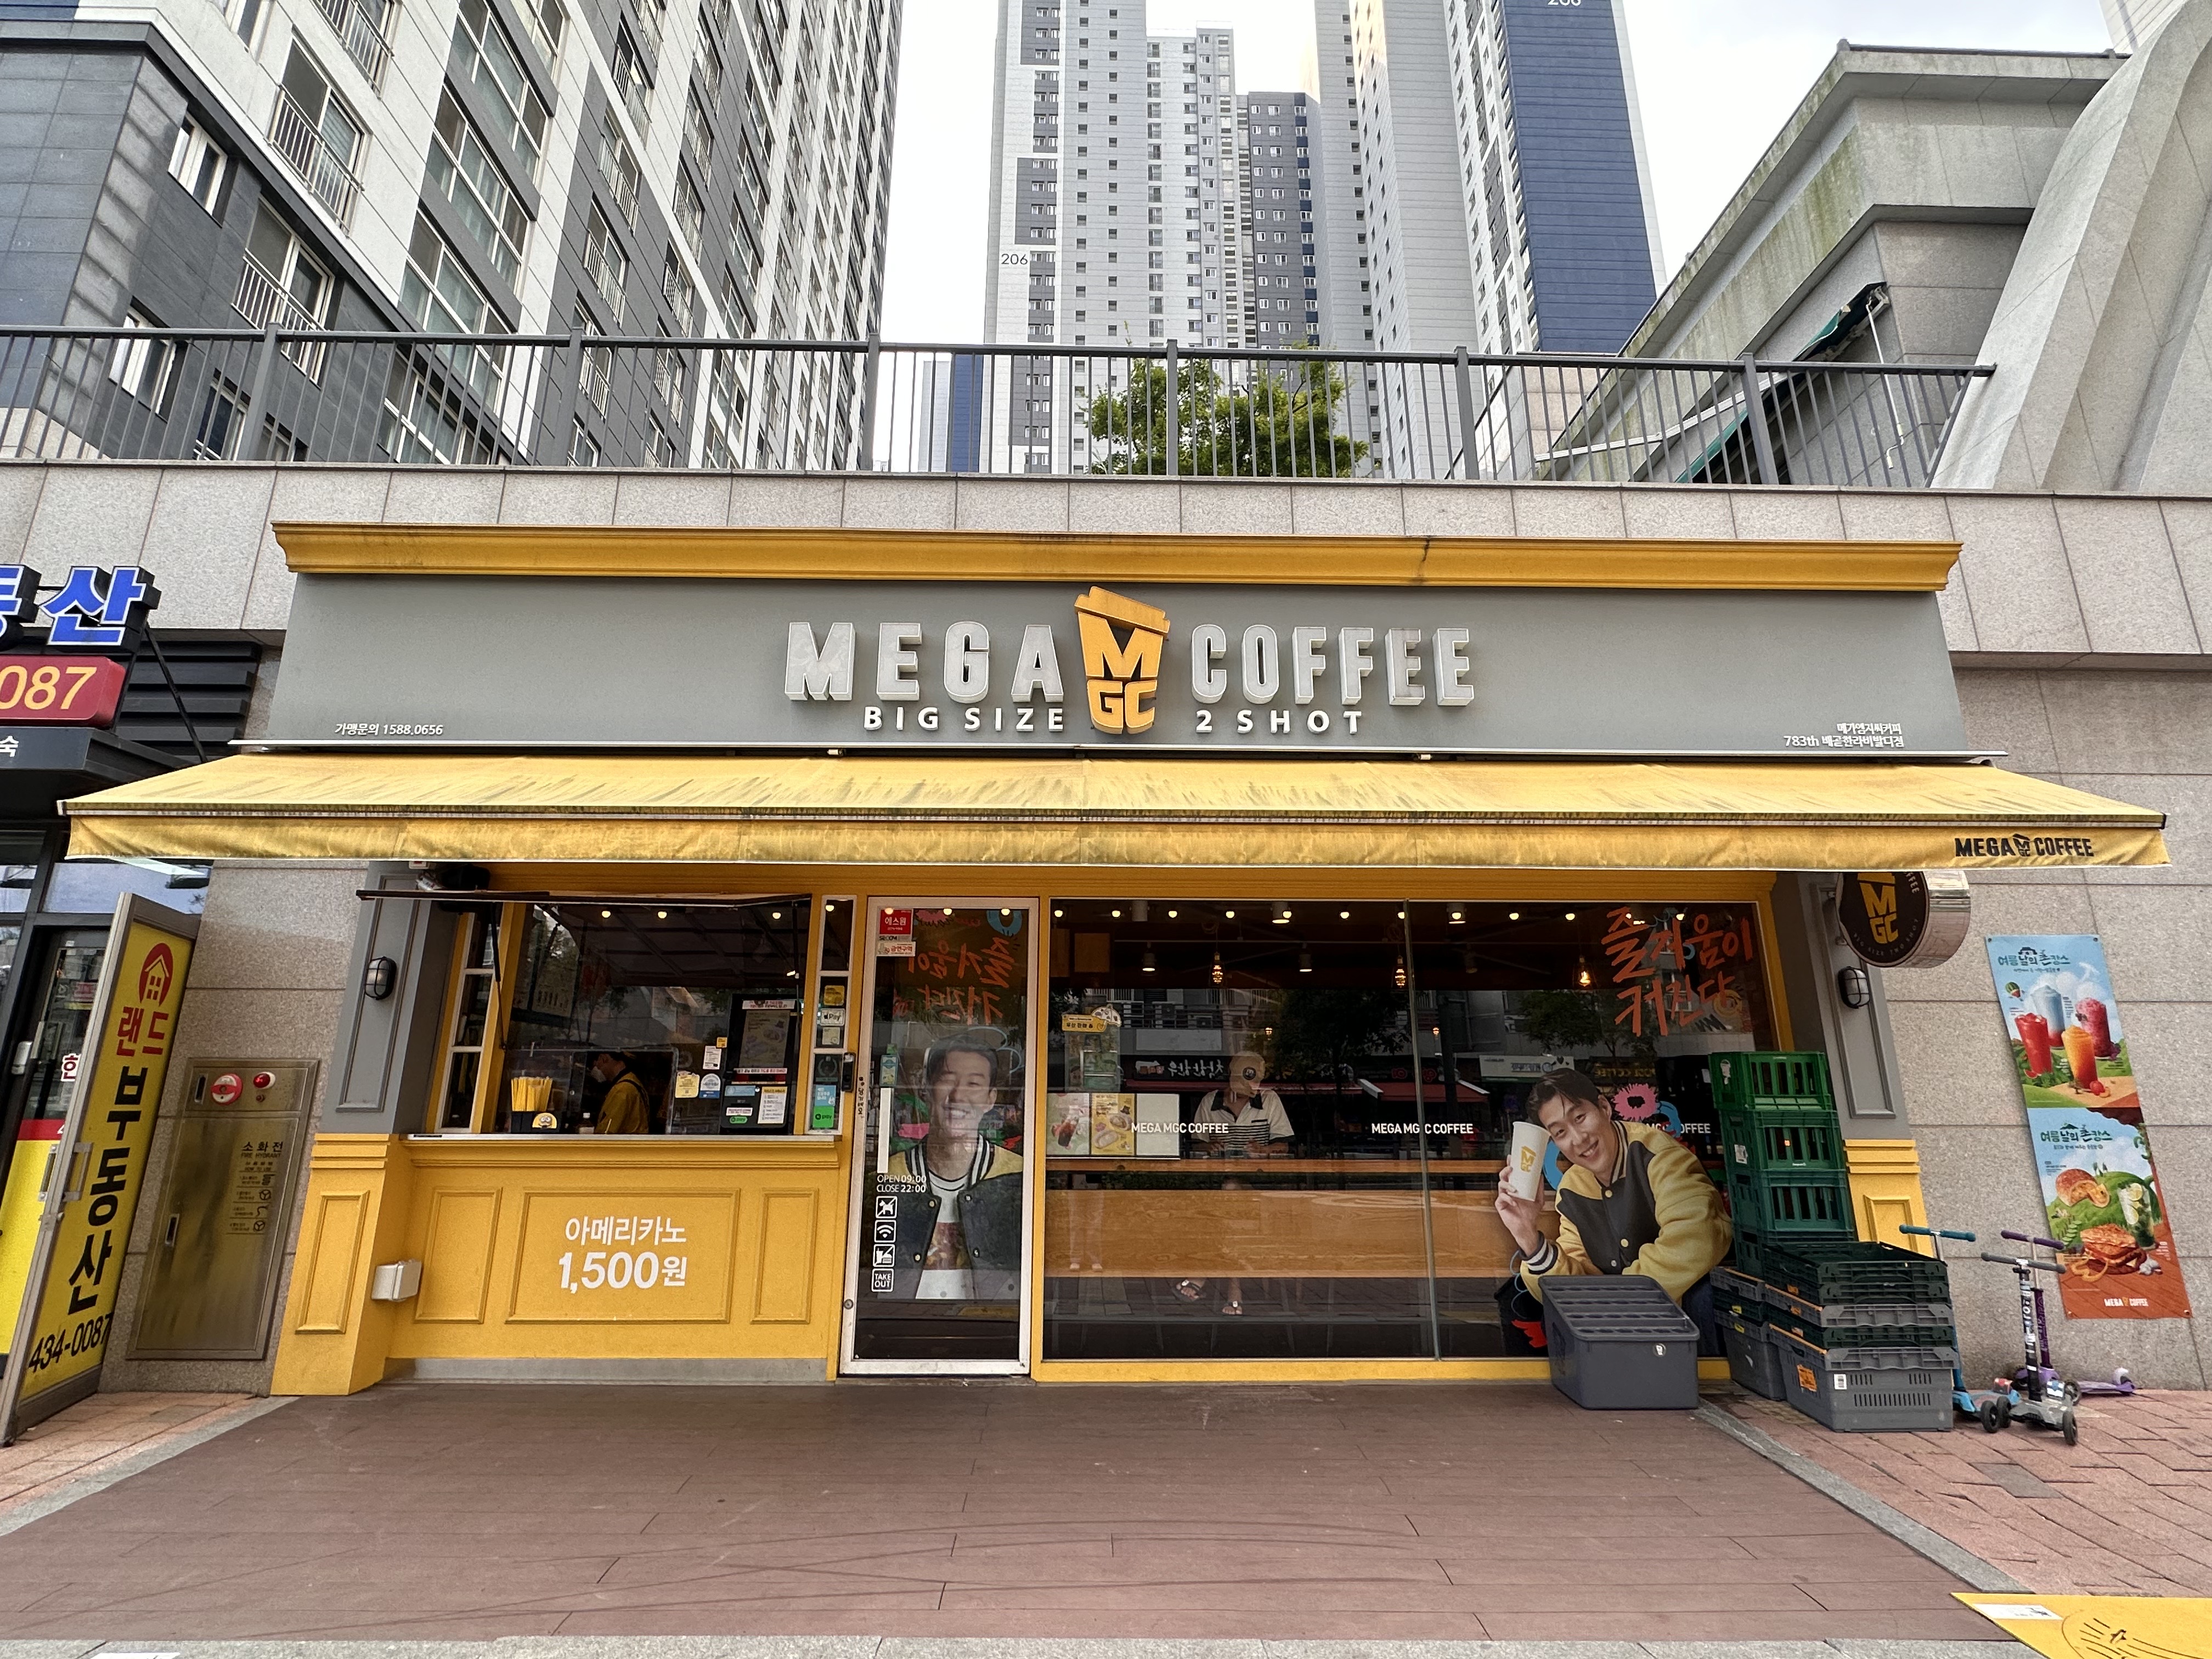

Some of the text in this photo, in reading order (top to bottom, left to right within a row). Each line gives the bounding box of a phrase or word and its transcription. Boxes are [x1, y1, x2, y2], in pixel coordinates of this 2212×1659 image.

[1001, 253, 1028, 265] 206
[785, 621, 1064, 703] MEGA
[1191, 624, 1475, 707] COFFEE
[0, 665, 97, 710] 087
[335, 723, 443, 735] 가맹문의 1588.0656
[864, 706, 1064, 732] BIG SIZE
[1195, 709, 1362, 734] 2 SHOT
[1784, 735, 1820, 747] 783th
[1955, 837, 2016, 857] MEGA
[2034, 837, 2094, 856] COFFEE
[1601, 906, 1754, 983] 즐거움이
[1615, 971, 1736, 1037] 커진다
[1131, 1123, 1229, 1133] MEGA MGC COFFEE
[1372, 1123, 1402, 1133] MEGA
[1433, 1124, 1474, 1134] COFFEE
[241, 1141, 283, 1152] 소화전
[67, 1065, 148, 1316] 부동산
[877, 1175, 927, 1183] OPEN 09:00
[877, 1184, 926, 1193] CLOSE 22:00
[565, 1216, 686, 1246] 아메리카노
[558, 1251, 687, 1294] 1,500원
[29, 1312, 114, 1374] 434-0087
